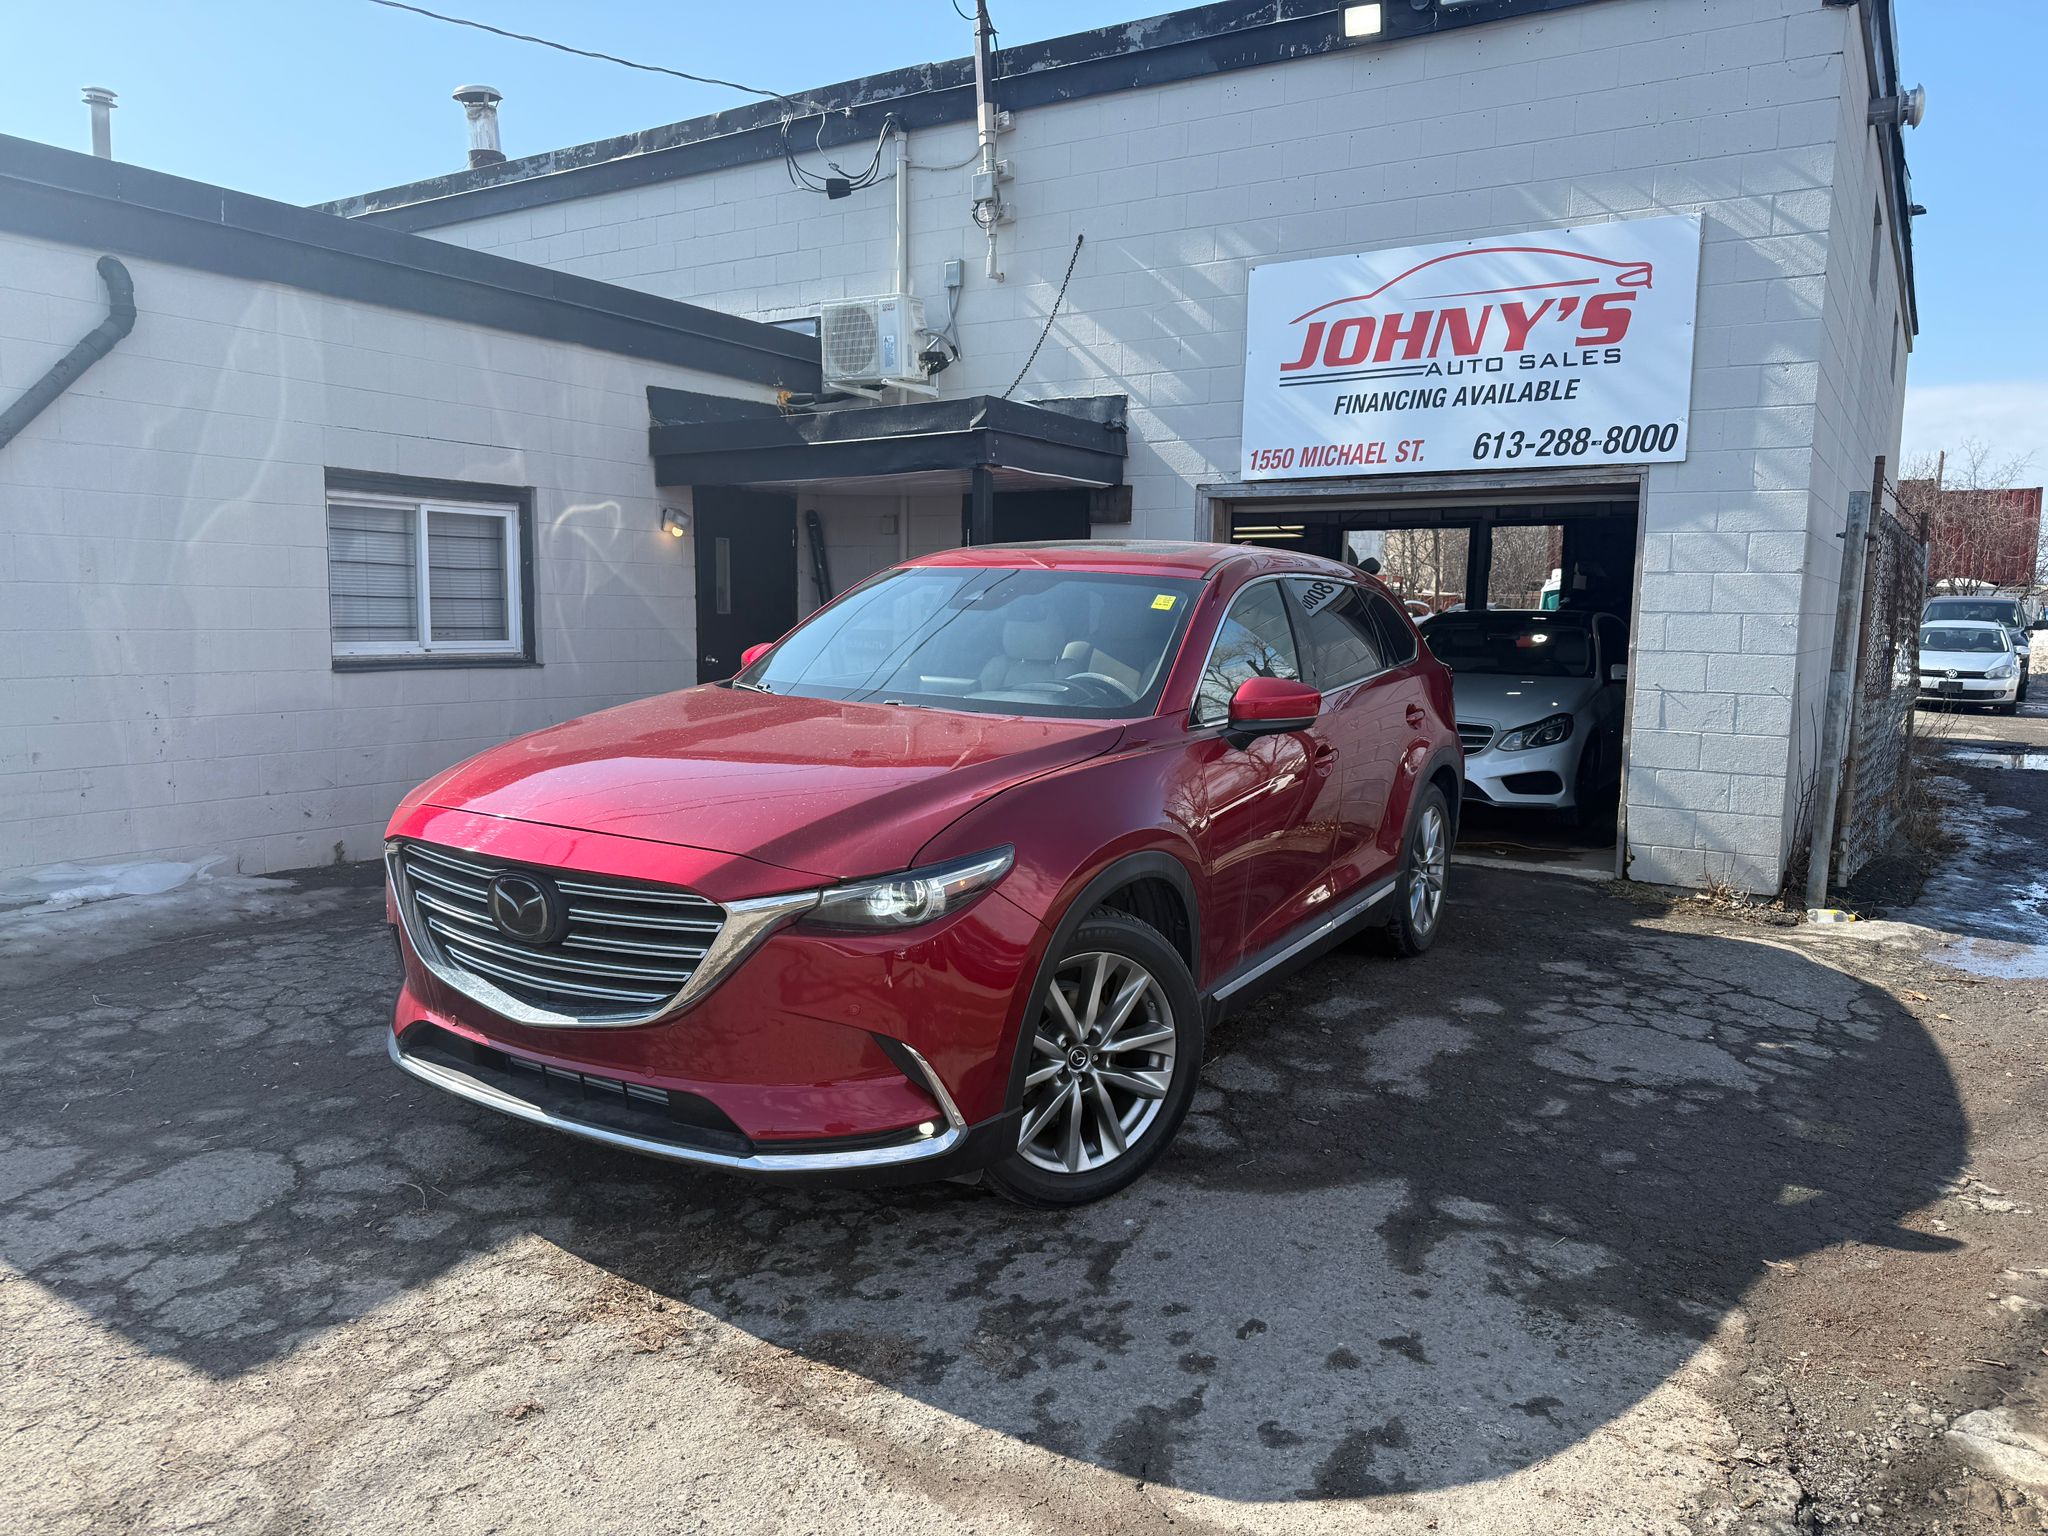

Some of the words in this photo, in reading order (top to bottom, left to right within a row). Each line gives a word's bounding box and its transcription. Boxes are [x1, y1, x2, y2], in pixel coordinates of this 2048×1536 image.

[1425, 358, 1503, 377] AUTO
[1519, 348, 1622, 370] SALES
[1334, 387, 1447, 415] FINANCING
[1451, 379, 1580, 408] AVAILABLE
[1250, 448, 1294, 470] 1550
[1299, 442, 1388, 468] MICHAEL
[1394, 440, 1425, 462] ST.
[1472, 423, 1679, 460] 613-288-8000
